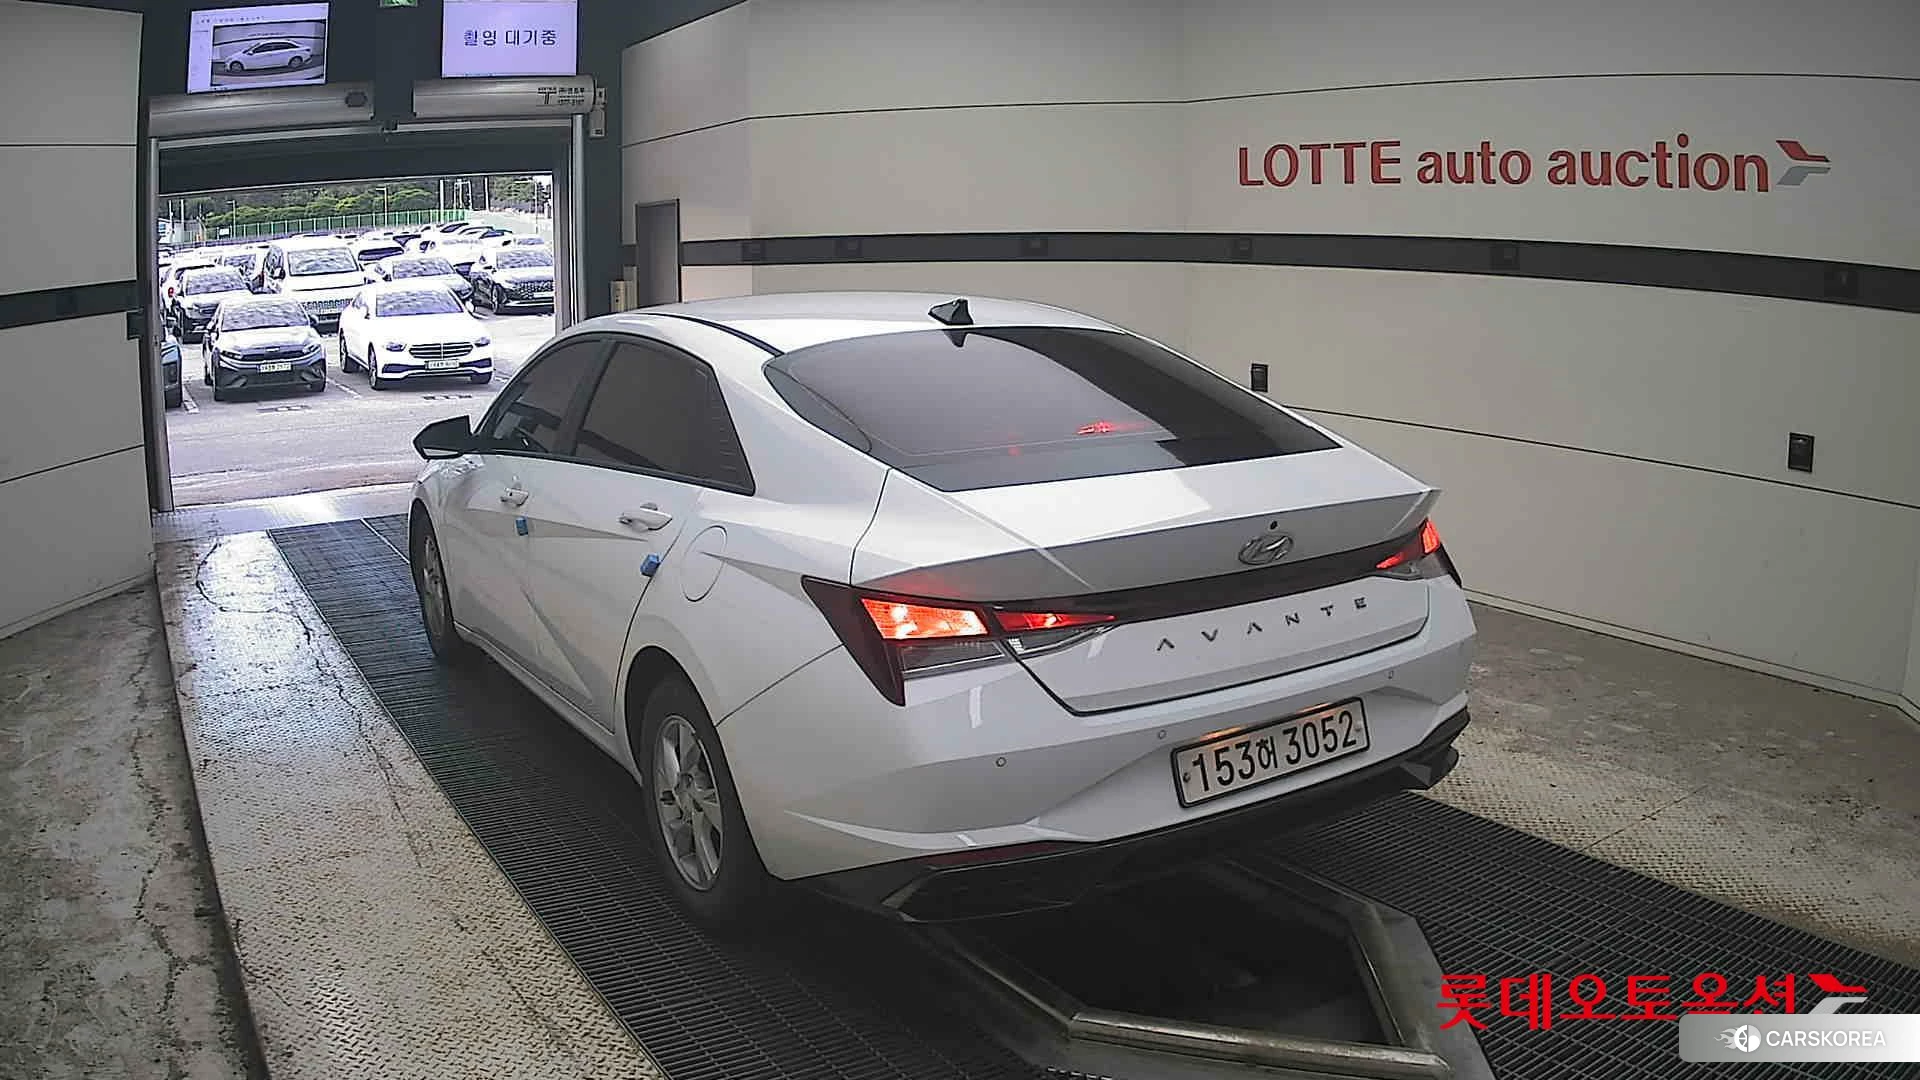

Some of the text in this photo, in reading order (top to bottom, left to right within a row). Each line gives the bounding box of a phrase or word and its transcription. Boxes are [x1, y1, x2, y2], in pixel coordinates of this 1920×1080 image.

[505, 29, 557, 47] 대기중
[1238, 133, 1770, 193] LOTTE auto auction
[1156, 596, 1368, 652] AVANTE
[1282, 710, 1357, 765] 3052
